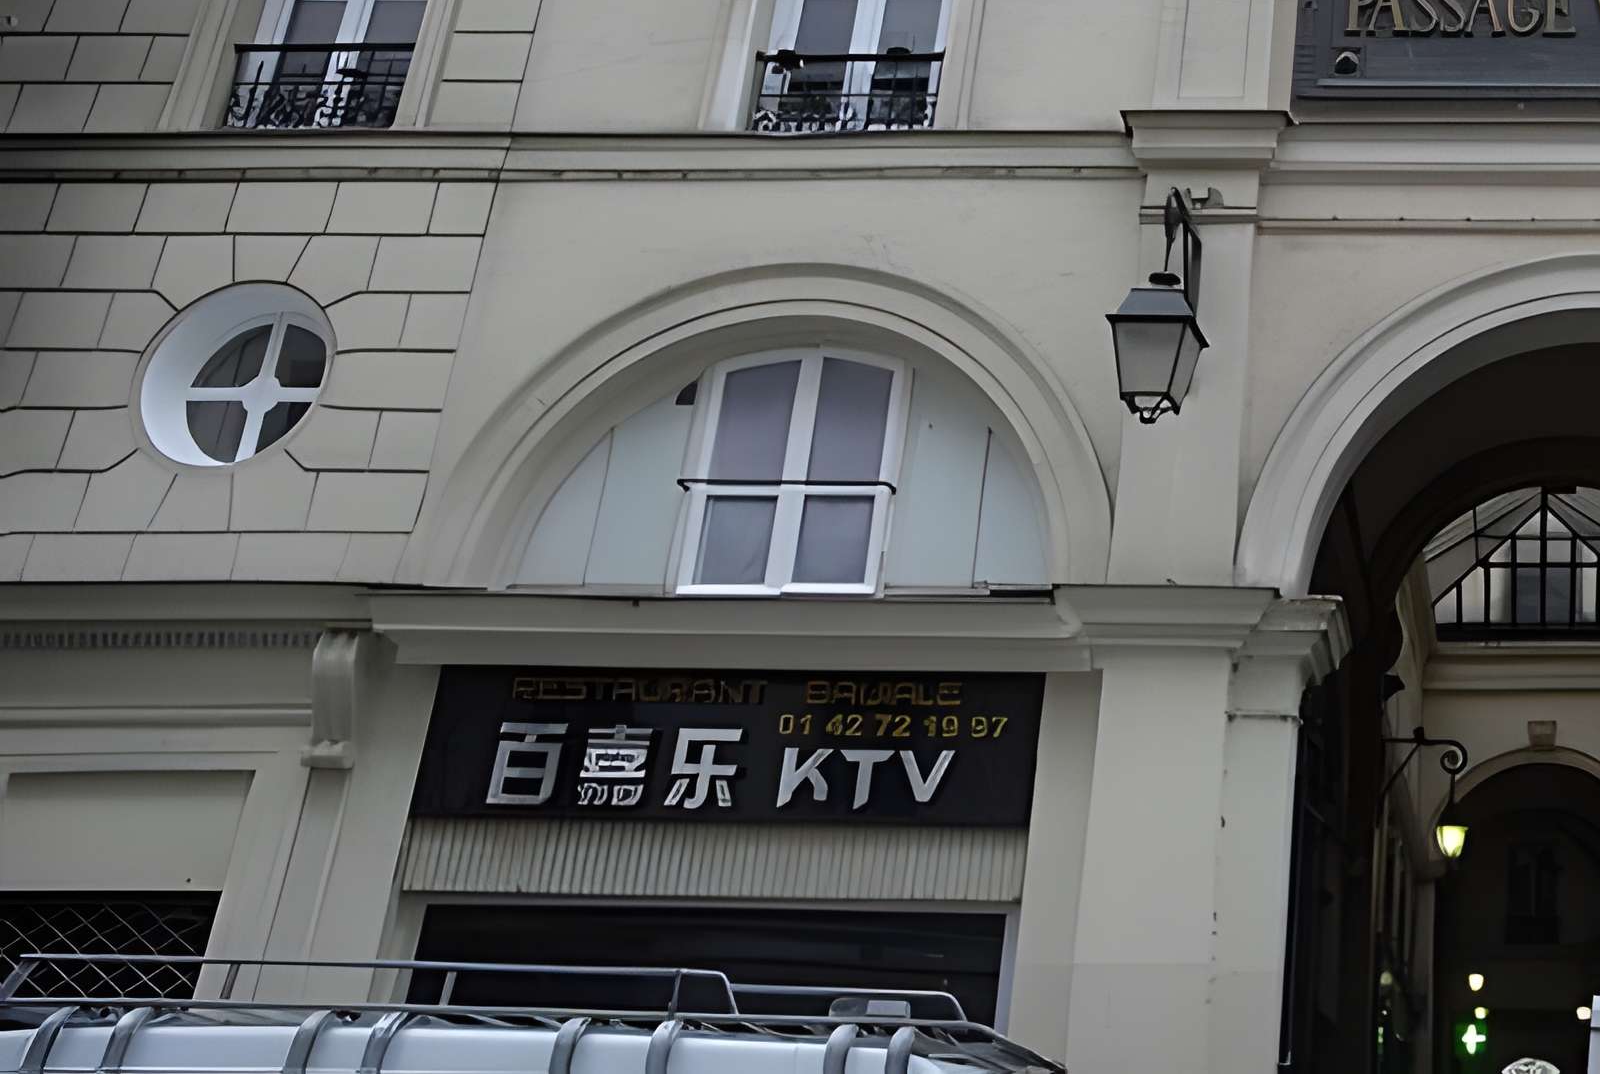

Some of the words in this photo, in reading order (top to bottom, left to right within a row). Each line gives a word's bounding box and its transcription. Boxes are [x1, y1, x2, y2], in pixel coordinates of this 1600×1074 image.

[513, 678, 768, 703] RESTAURANT
[779, 714, 812, 734] 01
[826, 714, 863, 736] 42
[874, 714, 911, 737] 72
[923, 716, 959, 737] 19
[776, 747, 956, 809] KTV
